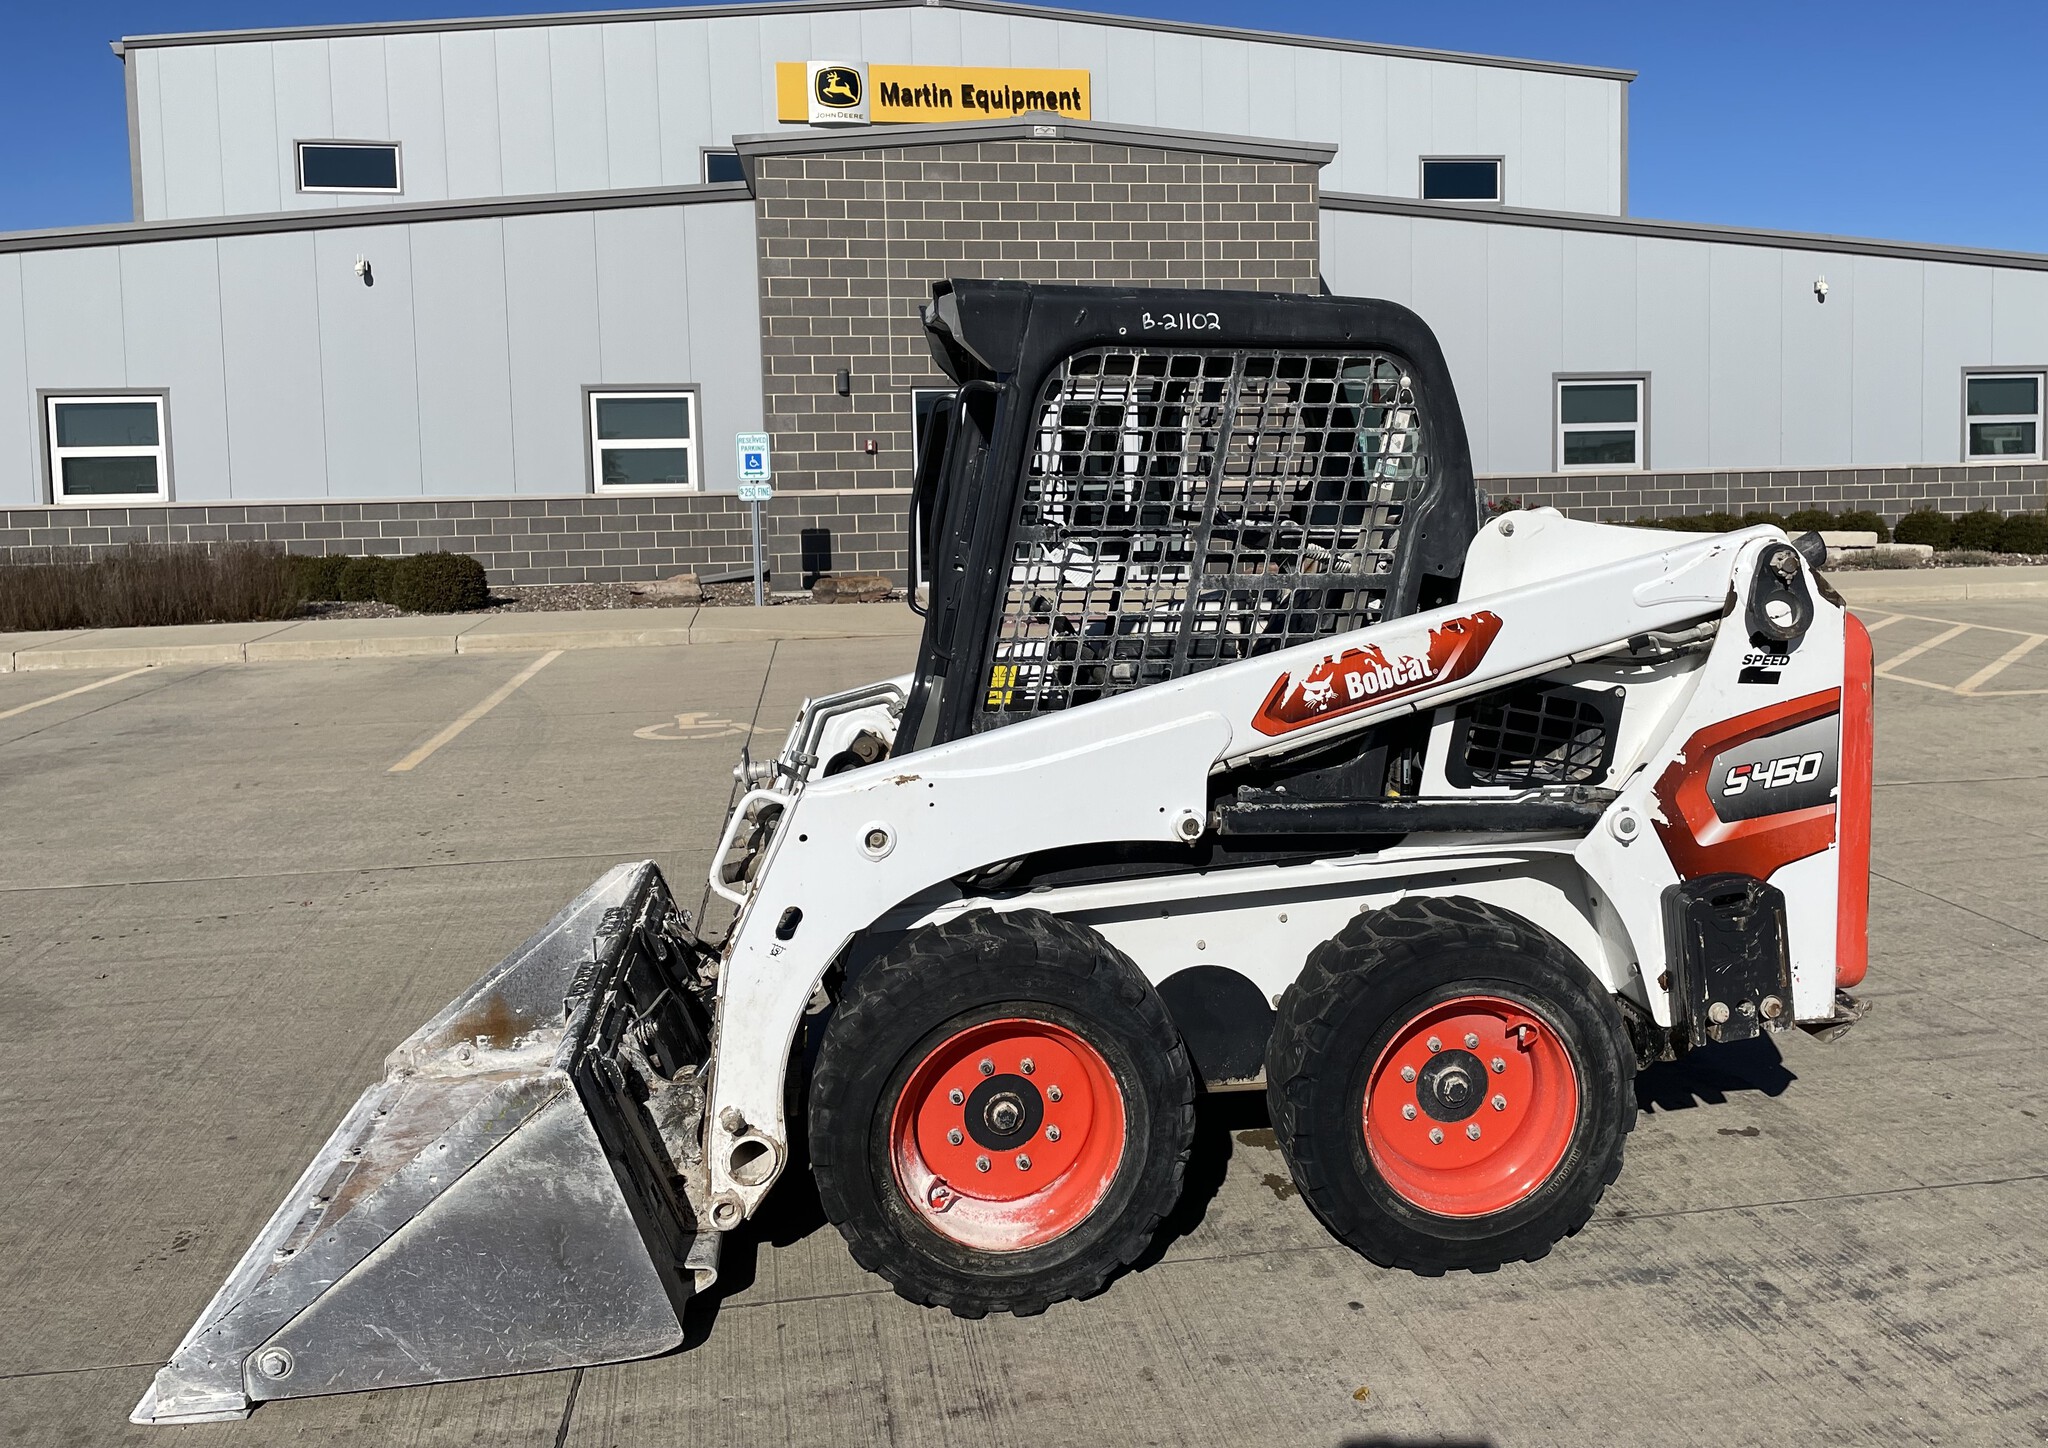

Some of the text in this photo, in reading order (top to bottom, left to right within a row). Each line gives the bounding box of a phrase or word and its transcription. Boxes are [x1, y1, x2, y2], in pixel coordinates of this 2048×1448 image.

[879, 82, 1082, 114] Martin Equipment
[838, 111, 864, 120] DEERE
[1142, 312, 1221, 331] B-21102
[757, 487, 770, 496] FINE
[1741, 654, 1791, 666] SPEED
[1344, 657, 1433, 700] Bobcat
[1722, 751, 1825, 797] S450
